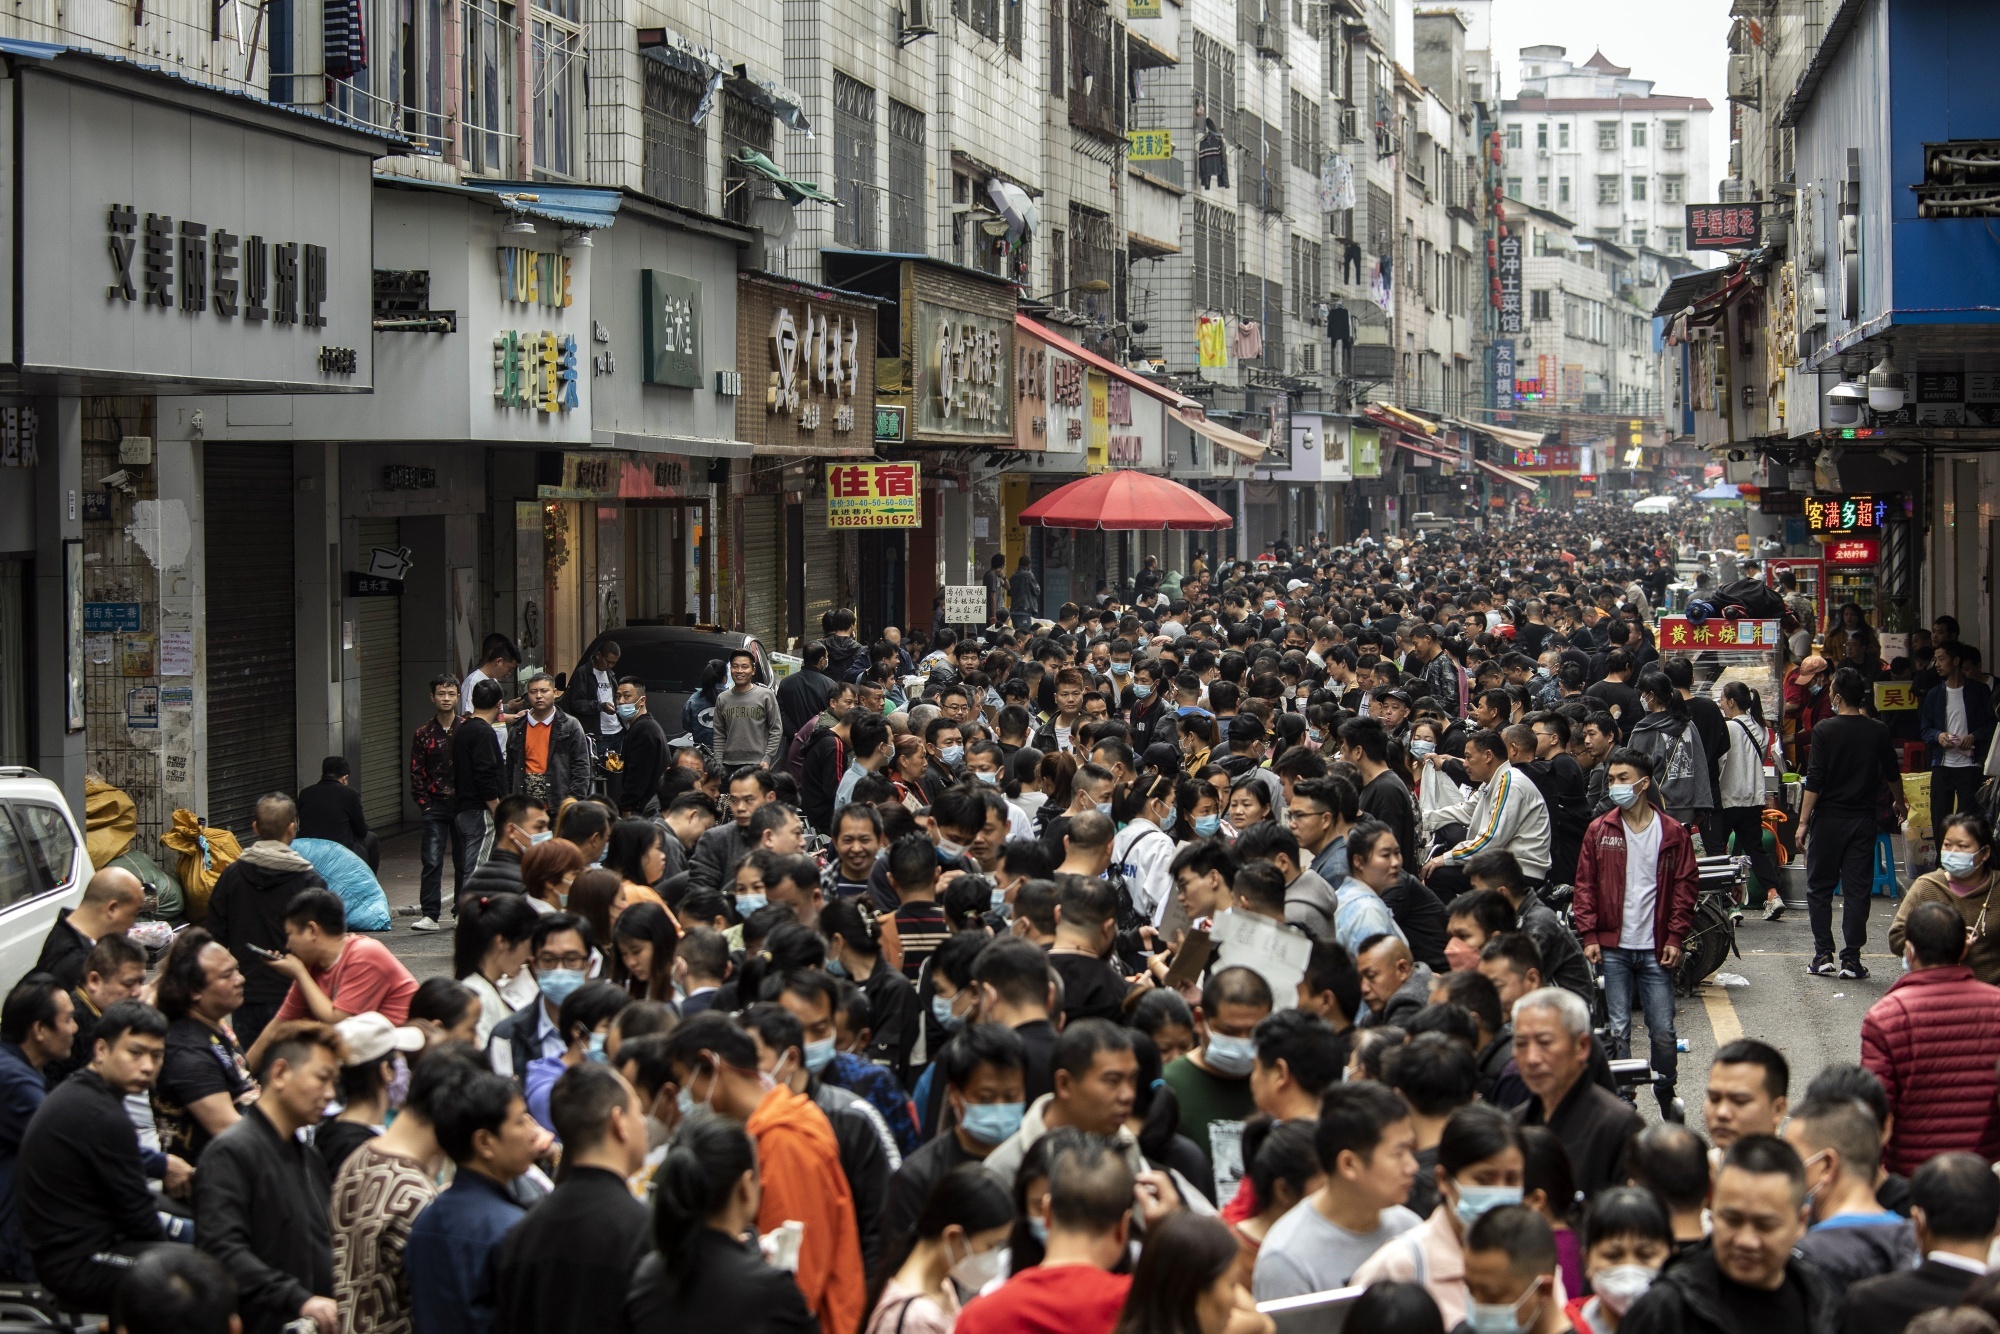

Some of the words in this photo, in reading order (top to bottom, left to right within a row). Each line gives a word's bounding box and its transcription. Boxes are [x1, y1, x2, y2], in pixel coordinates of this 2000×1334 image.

[1692, 207, 1754, 236] 手摇绣花
[108, 204, 327, 327] 艾美丽专业减肥
[502, 247, 538, 303] YUE
[542, 253, 572, 308] YUE
[1500, 238, 1520, 332] 台冲土菜馆
[665, 295, 693, 354] 益禾堂
[1496, 346, 1511, 409] 友和棋牌
[1923, 377, 1958, 391] 三盈
[1, 406, 39, 467] 退款
[829, 465, 914, 497] 住宿
[830, 515, 915, 526] 13826191672
[359, 580, 389, 591] 益禾堂
[724, 706, 762, 719] SUPERIOR
